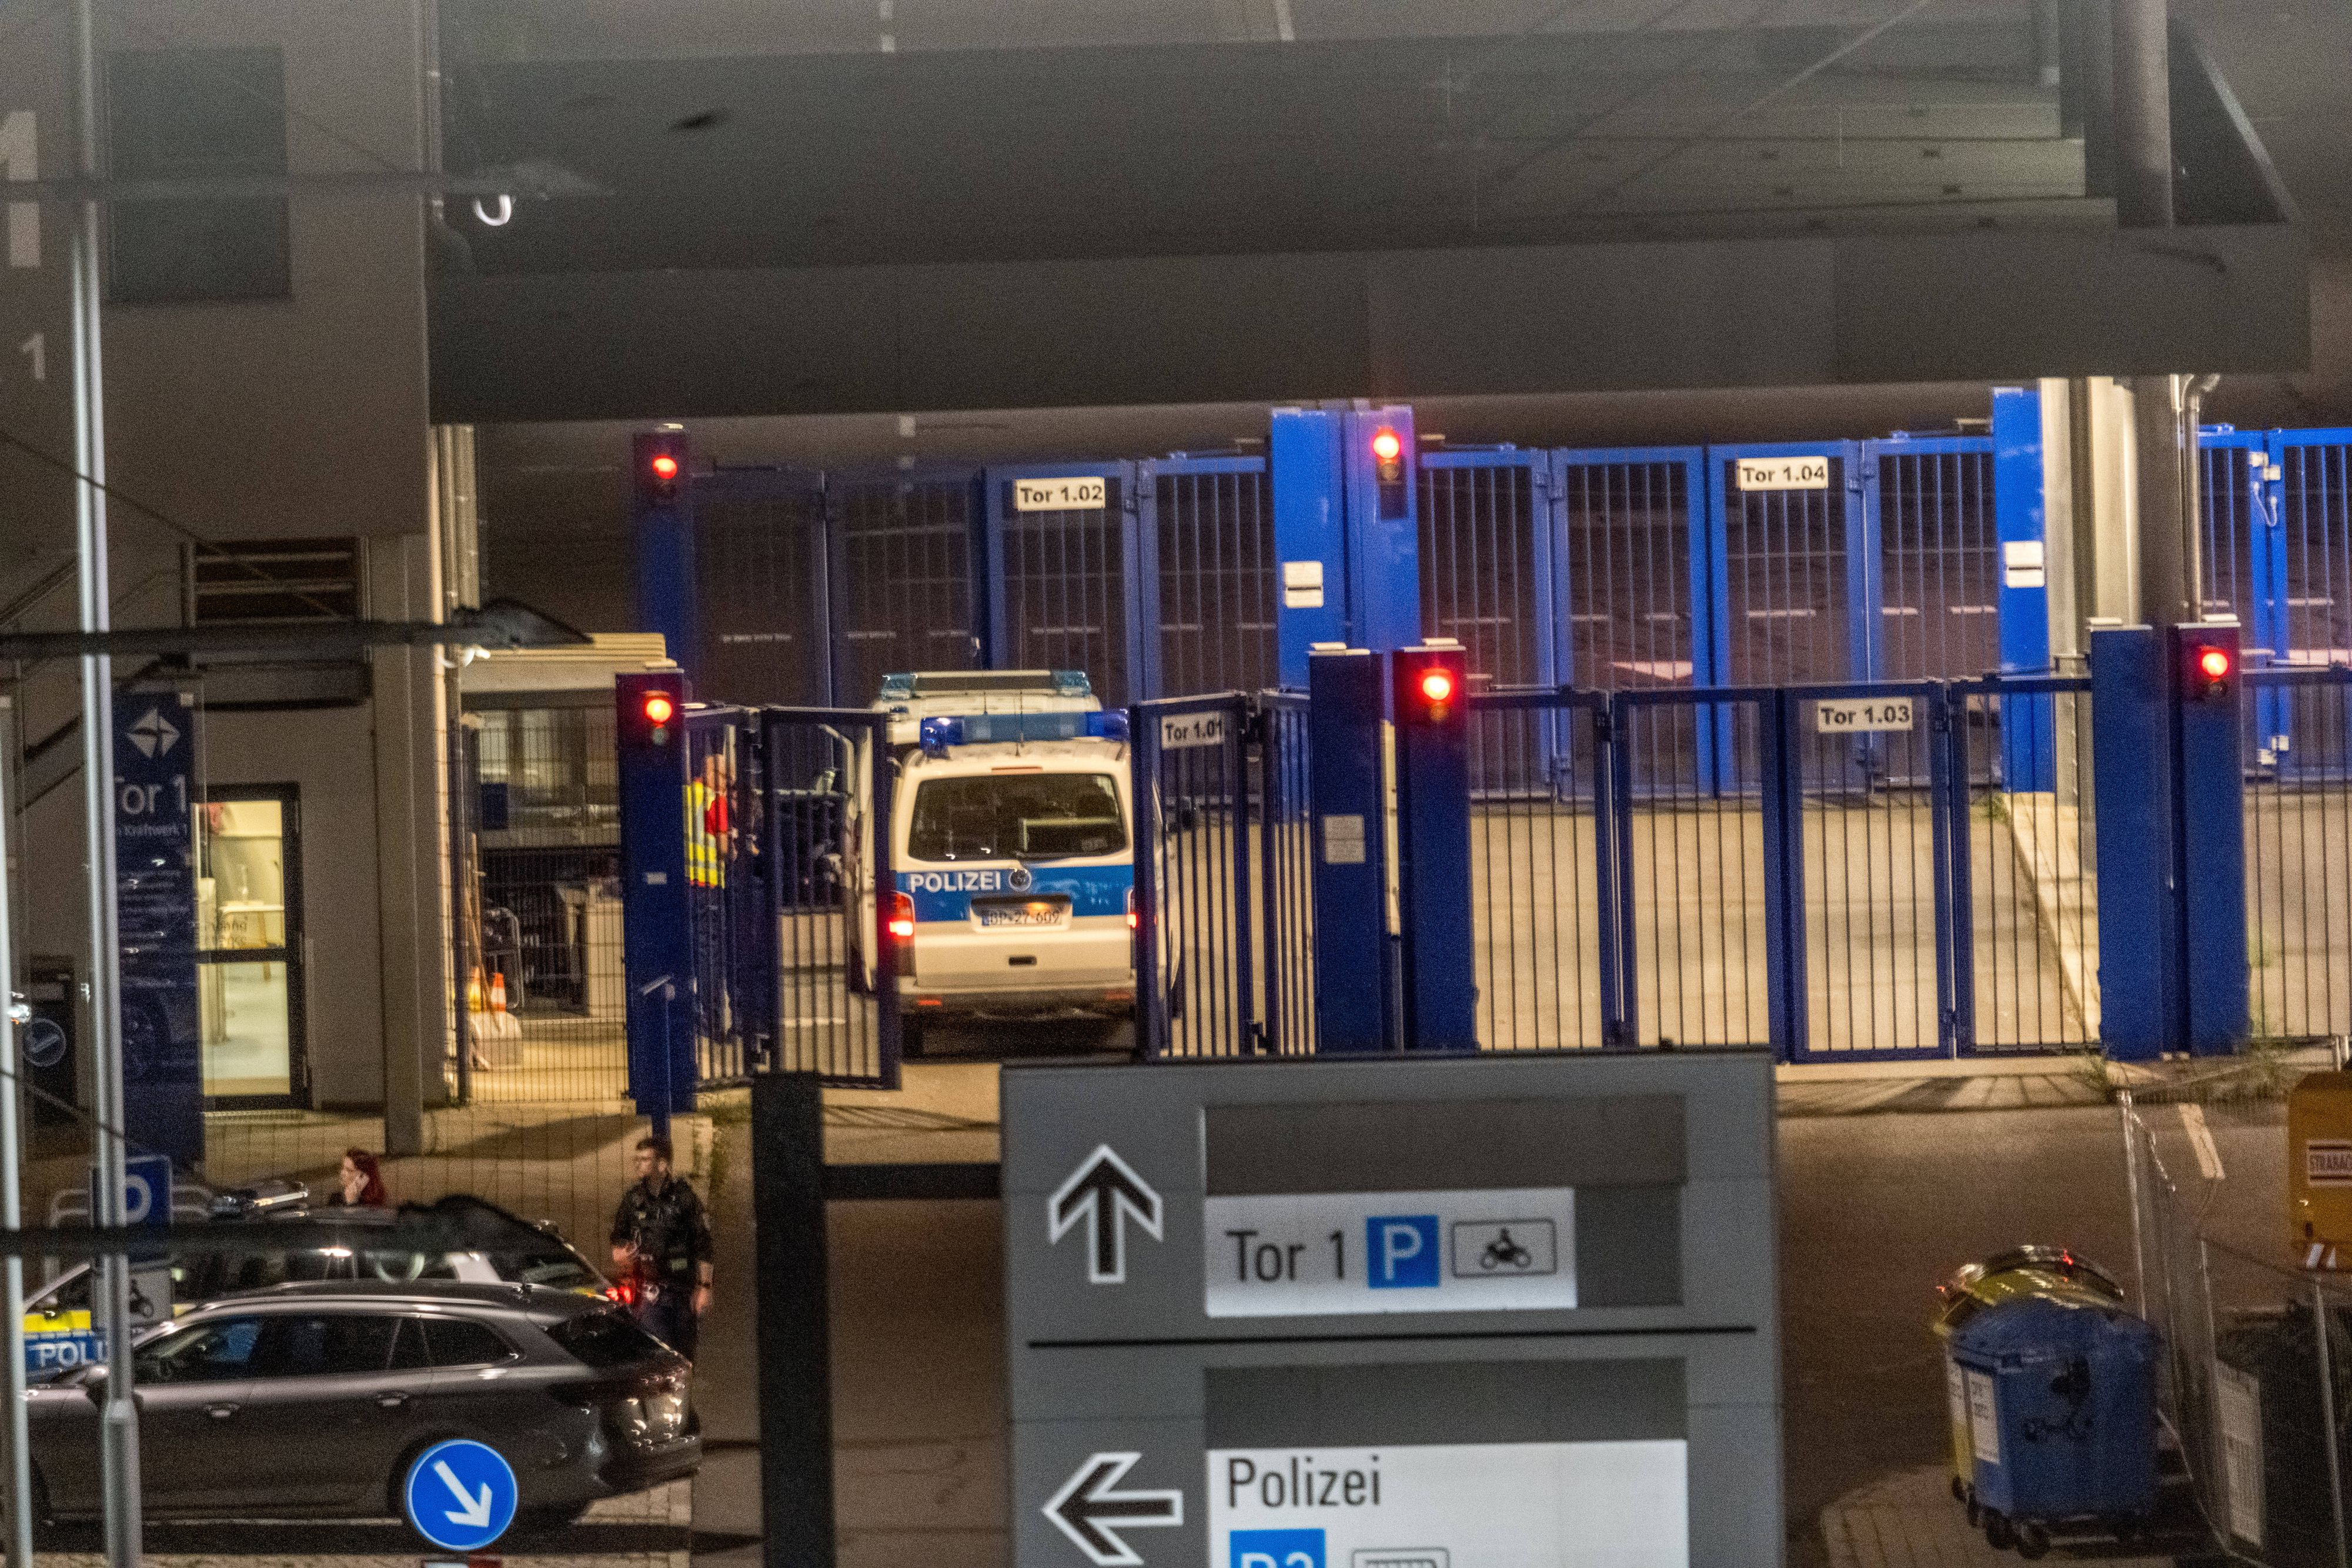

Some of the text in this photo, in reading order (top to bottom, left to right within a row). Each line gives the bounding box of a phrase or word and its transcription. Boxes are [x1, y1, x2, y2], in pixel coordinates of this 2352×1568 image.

[1742, 464, 1826, 483] Tor 1.04
[1020, 484, 1103, 503] Tor 1.02
[1821, 705, 1910, 725] Tor 1.03
[1165, 719, 1222, 742] Tor 1.01
[173, 773, 186, 814] 1
[910, 870, 1001, 894] POLIZEI
[1225, 1223, 1425, 1282] Tor 1 P
[39, 1341, 108, 1367] POLI
[1228, 1455, 1381, 1508] Polizei
